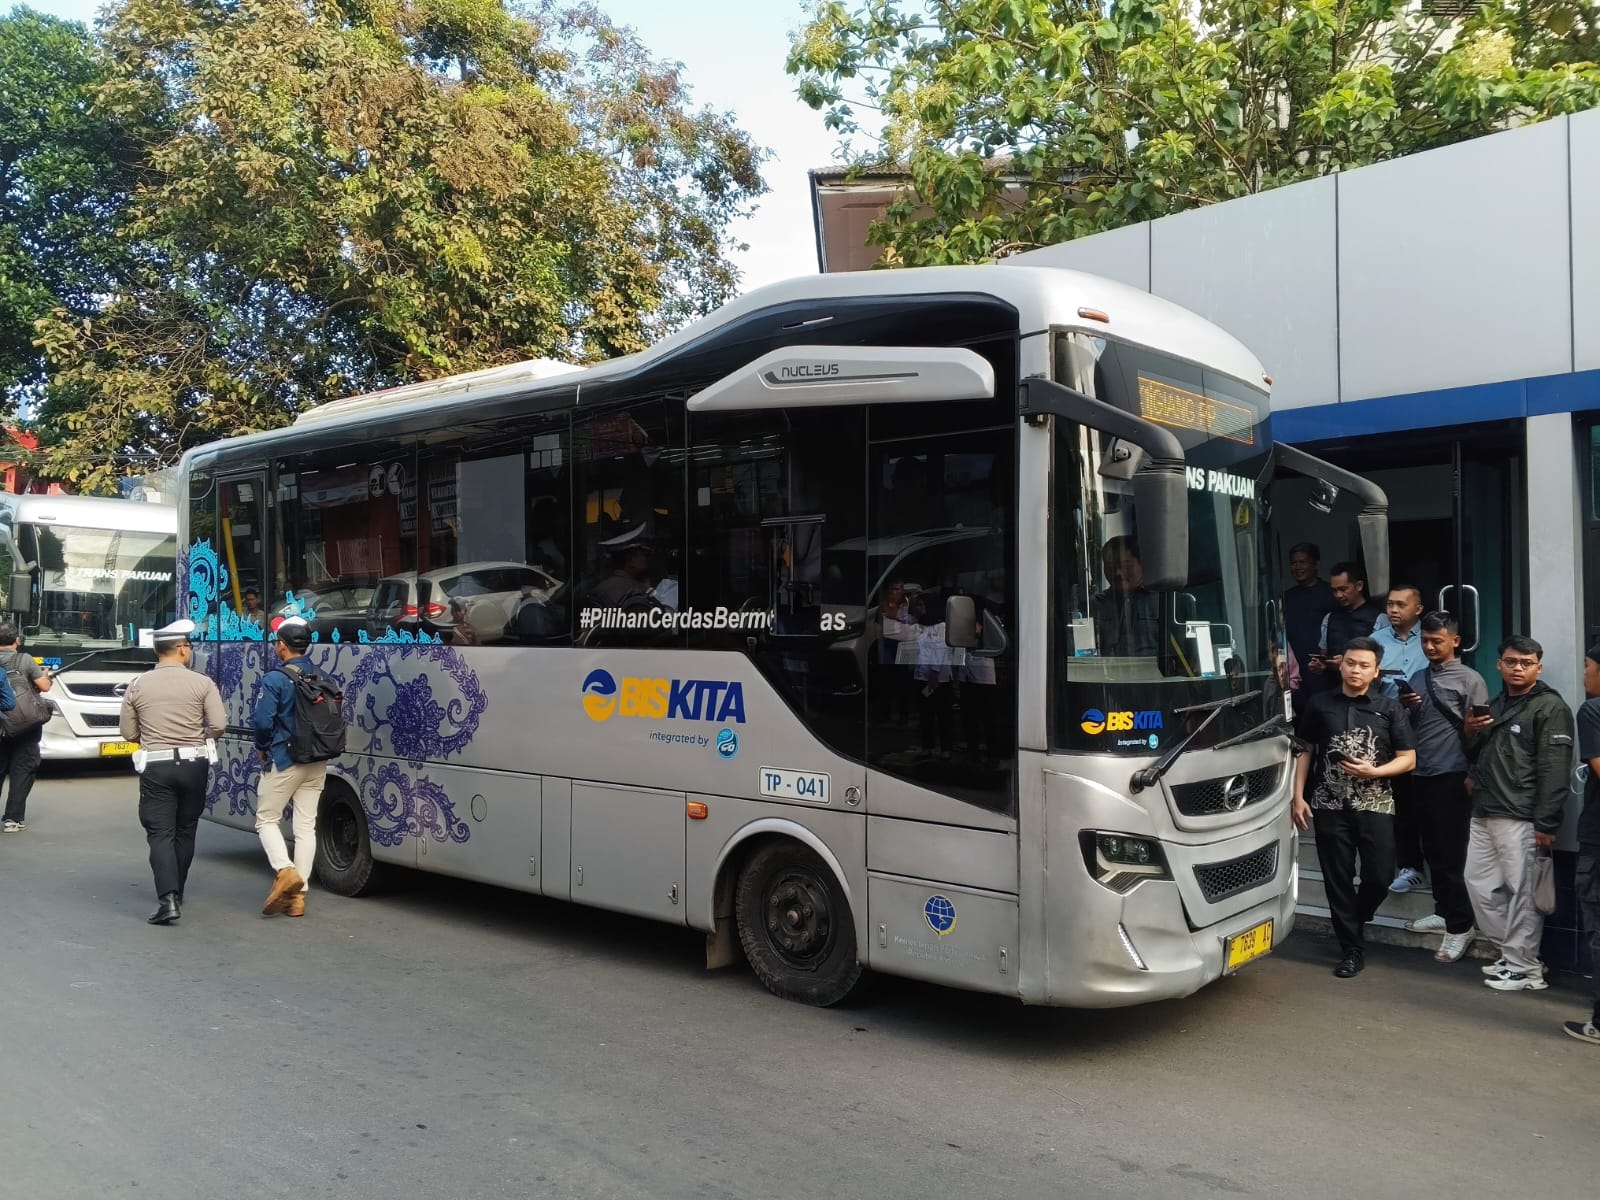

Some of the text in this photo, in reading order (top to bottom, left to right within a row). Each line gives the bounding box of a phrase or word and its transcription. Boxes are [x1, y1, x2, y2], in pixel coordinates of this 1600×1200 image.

[781, 363, 839, 377] NUCLEUS
[1208, 470, 1255, 500] PAKUAN
[76, 567, 172, 581] TRANS PAKUAN
[580, 606, 847, 632] #PilihanCerdasBermas
[649, 729, 696, 745] integrated
[697, 734, 709, 748] by
[765, 773, 782, 792] TP
[796, 776, 825, 798] 041
